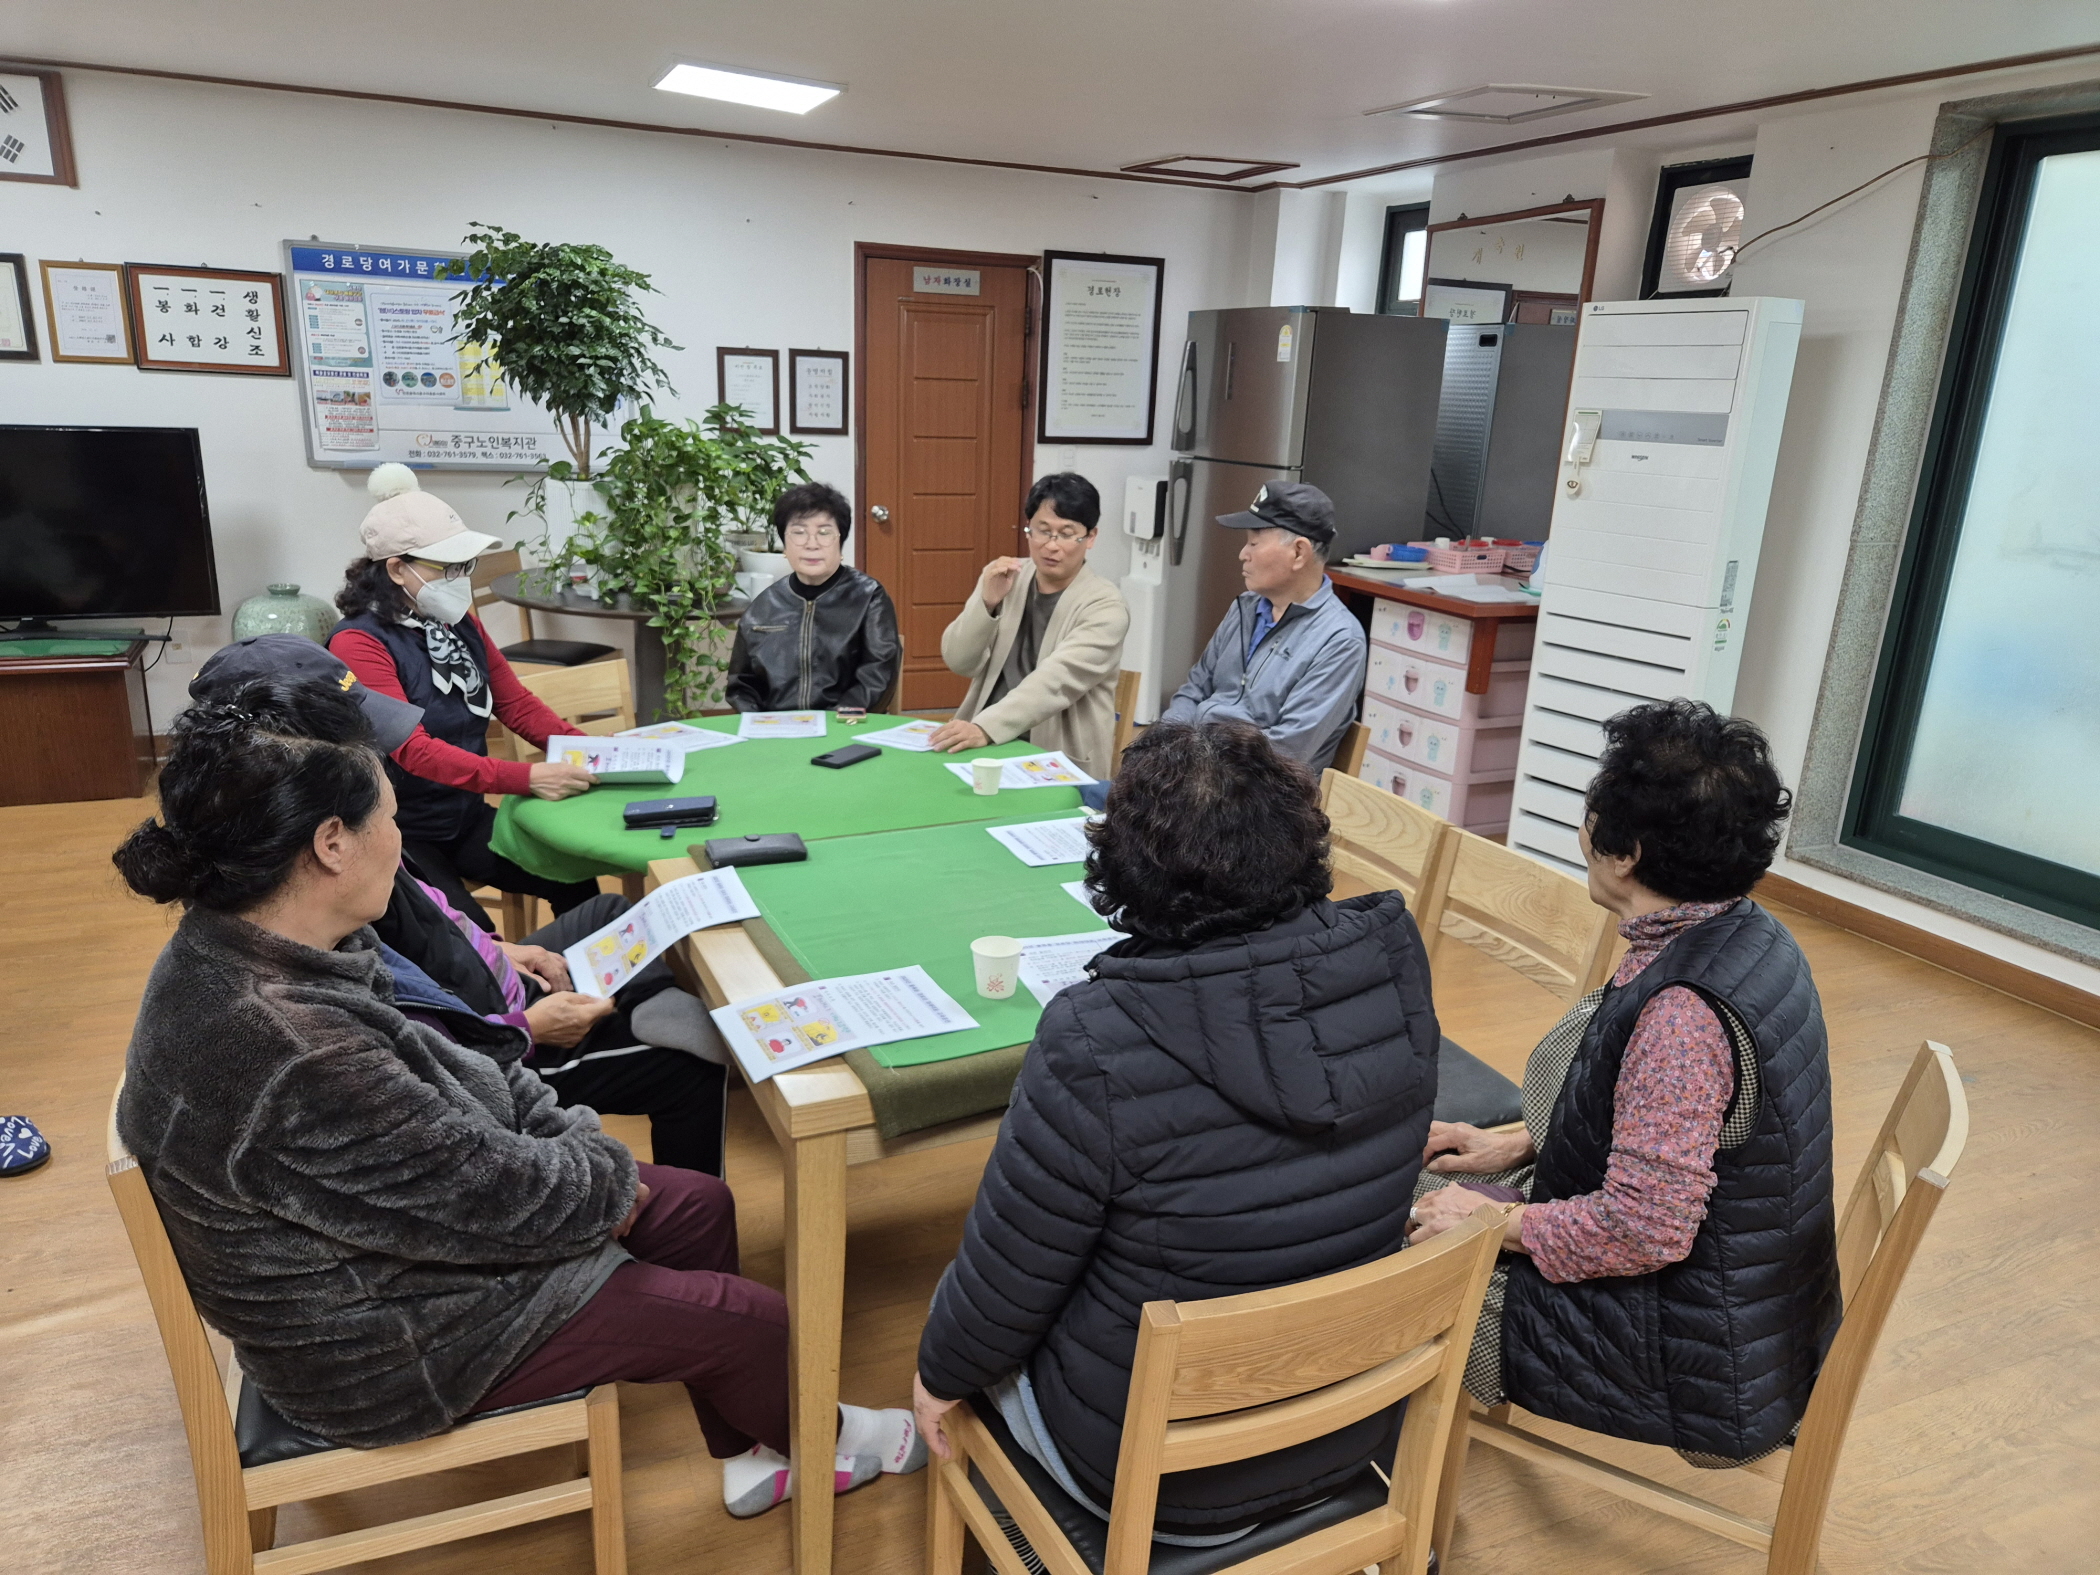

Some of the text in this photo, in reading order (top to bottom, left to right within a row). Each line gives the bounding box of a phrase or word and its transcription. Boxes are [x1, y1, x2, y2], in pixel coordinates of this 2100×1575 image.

[242, 290, 265, 357] 생활신조
[450, 434, 537, 451] 중구노인복지관
[0, 1116, 26, 1142] Love
